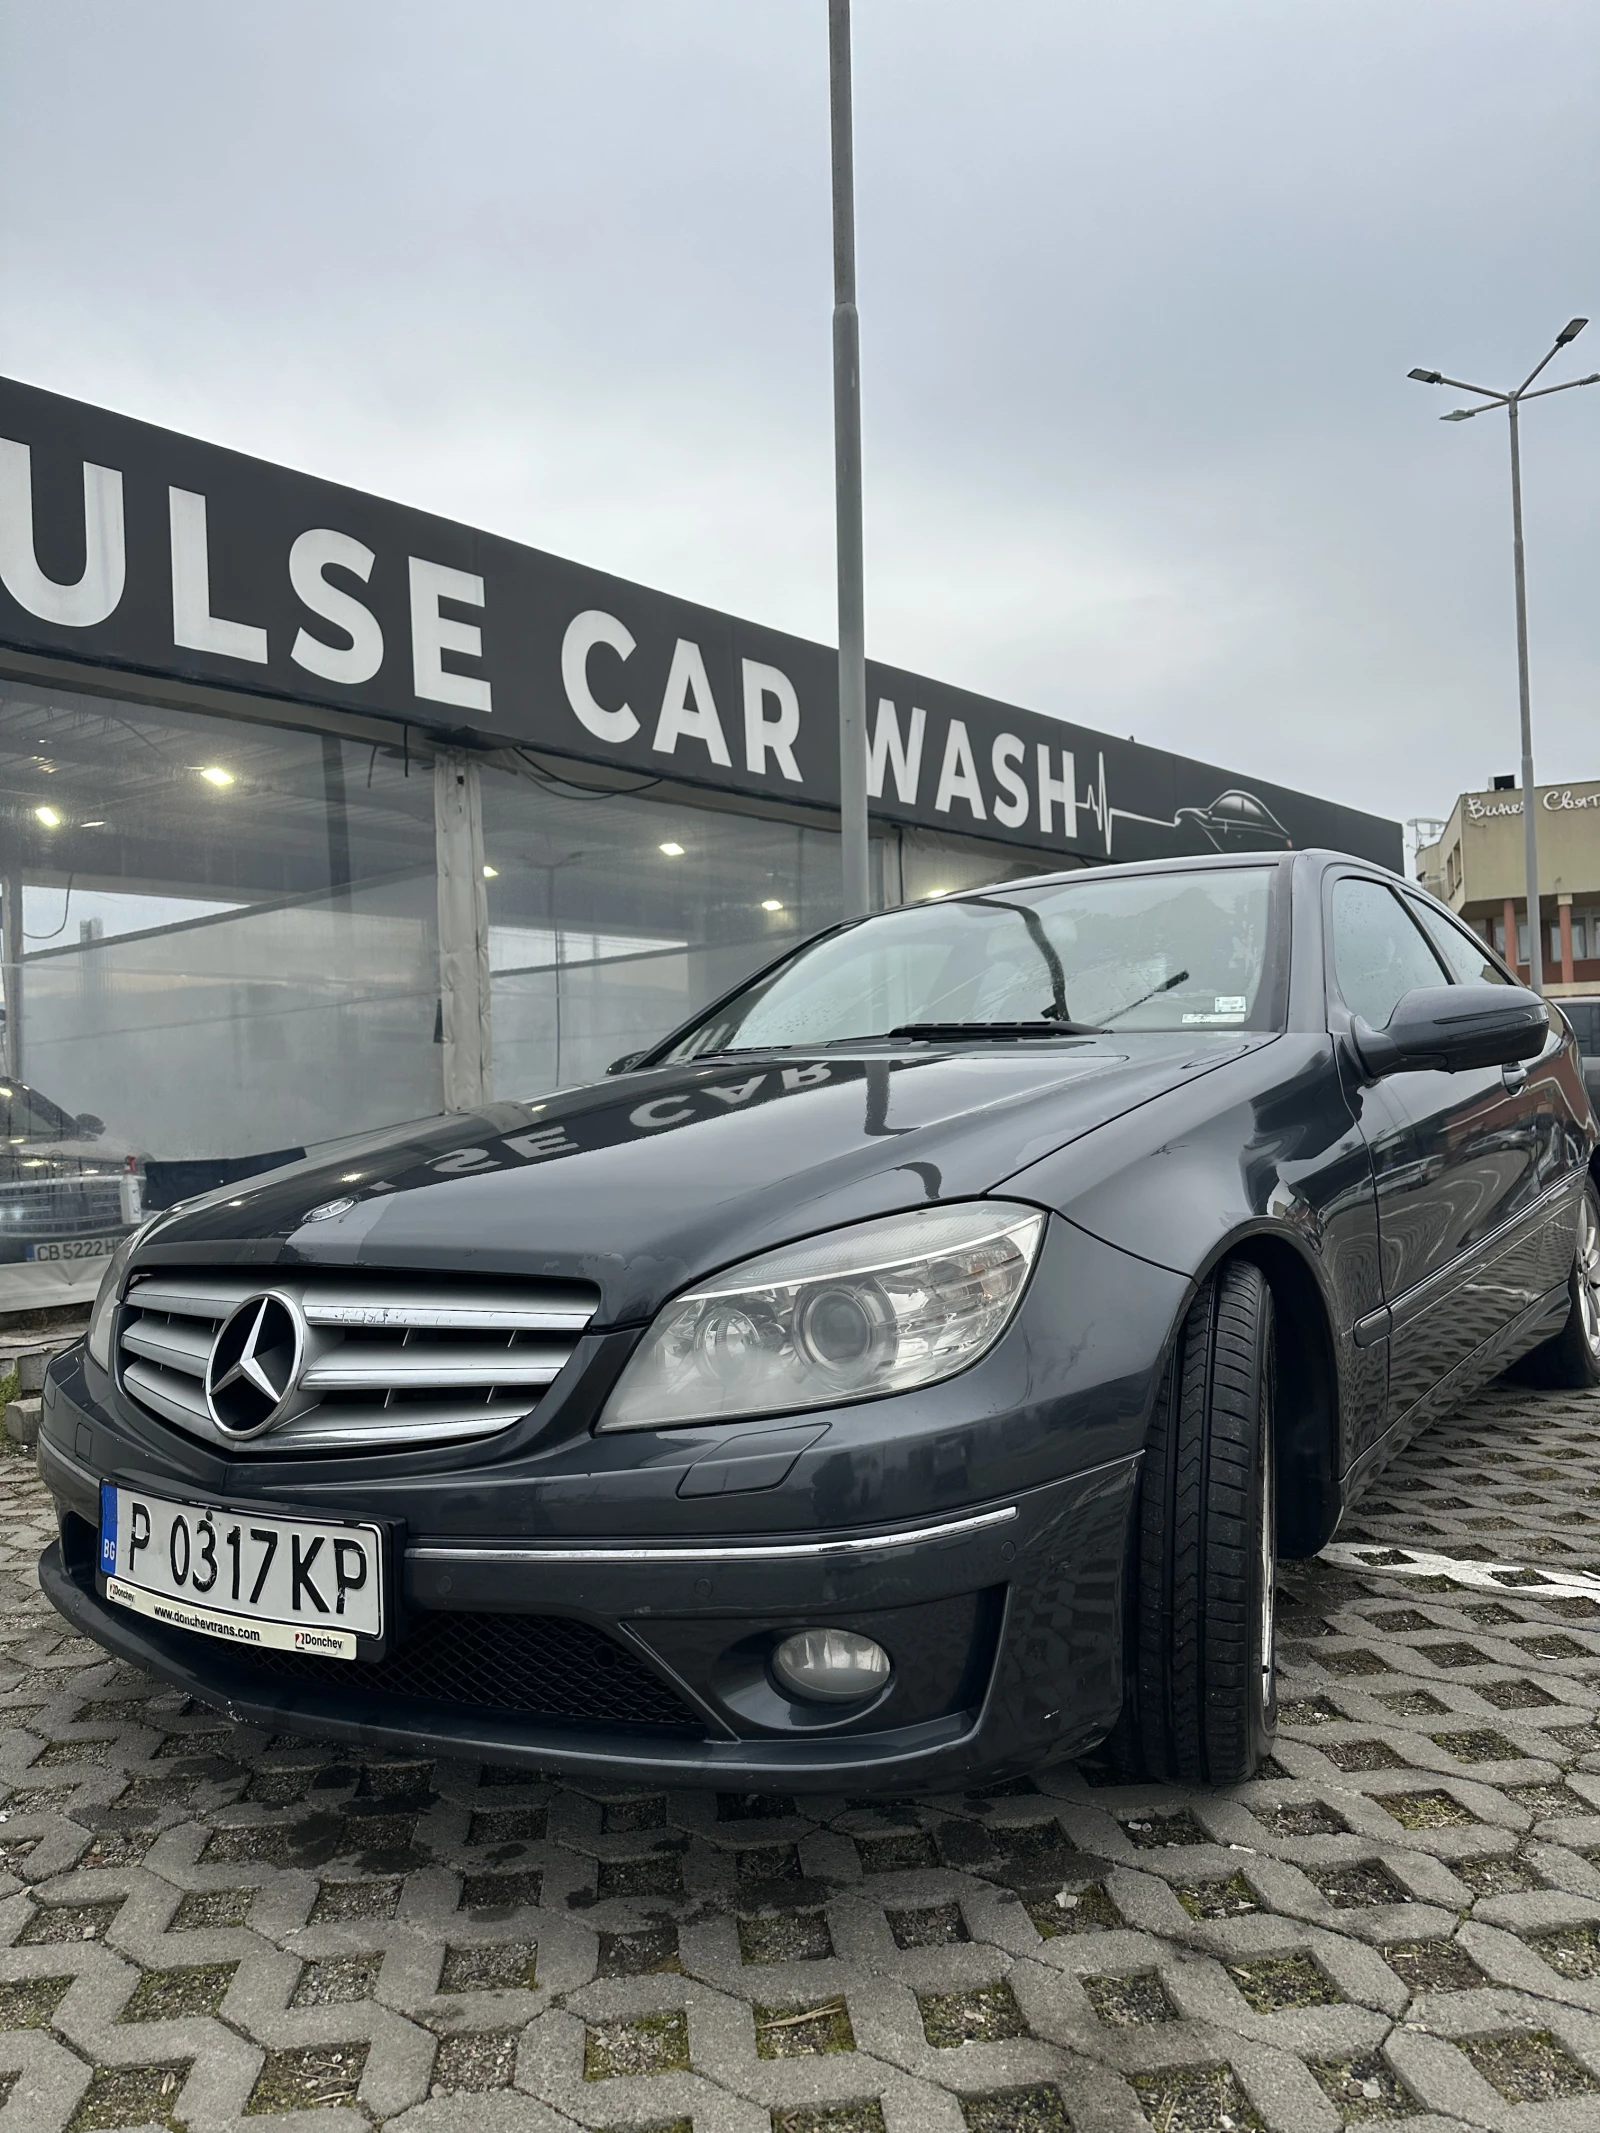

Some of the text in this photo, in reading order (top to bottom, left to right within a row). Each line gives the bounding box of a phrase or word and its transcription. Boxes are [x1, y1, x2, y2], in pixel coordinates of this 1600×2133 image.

[0, 436, 1078, 838] ULSE CAR WASH
[1468, 798, 1524, 819] Вине
[37, 1245, 60, 1261] CB
[63, 1240, 103, 1260] 5222
[104, 1538, 115, 1560] BG
[129, 1502, 368, 1615] P 0317 KP
[114, 1584, 135, 1602] Donchev
[154, 1605, 261, 1641] www.donchevtrans.com
[305, 1633, 343, 1650] Donchev
